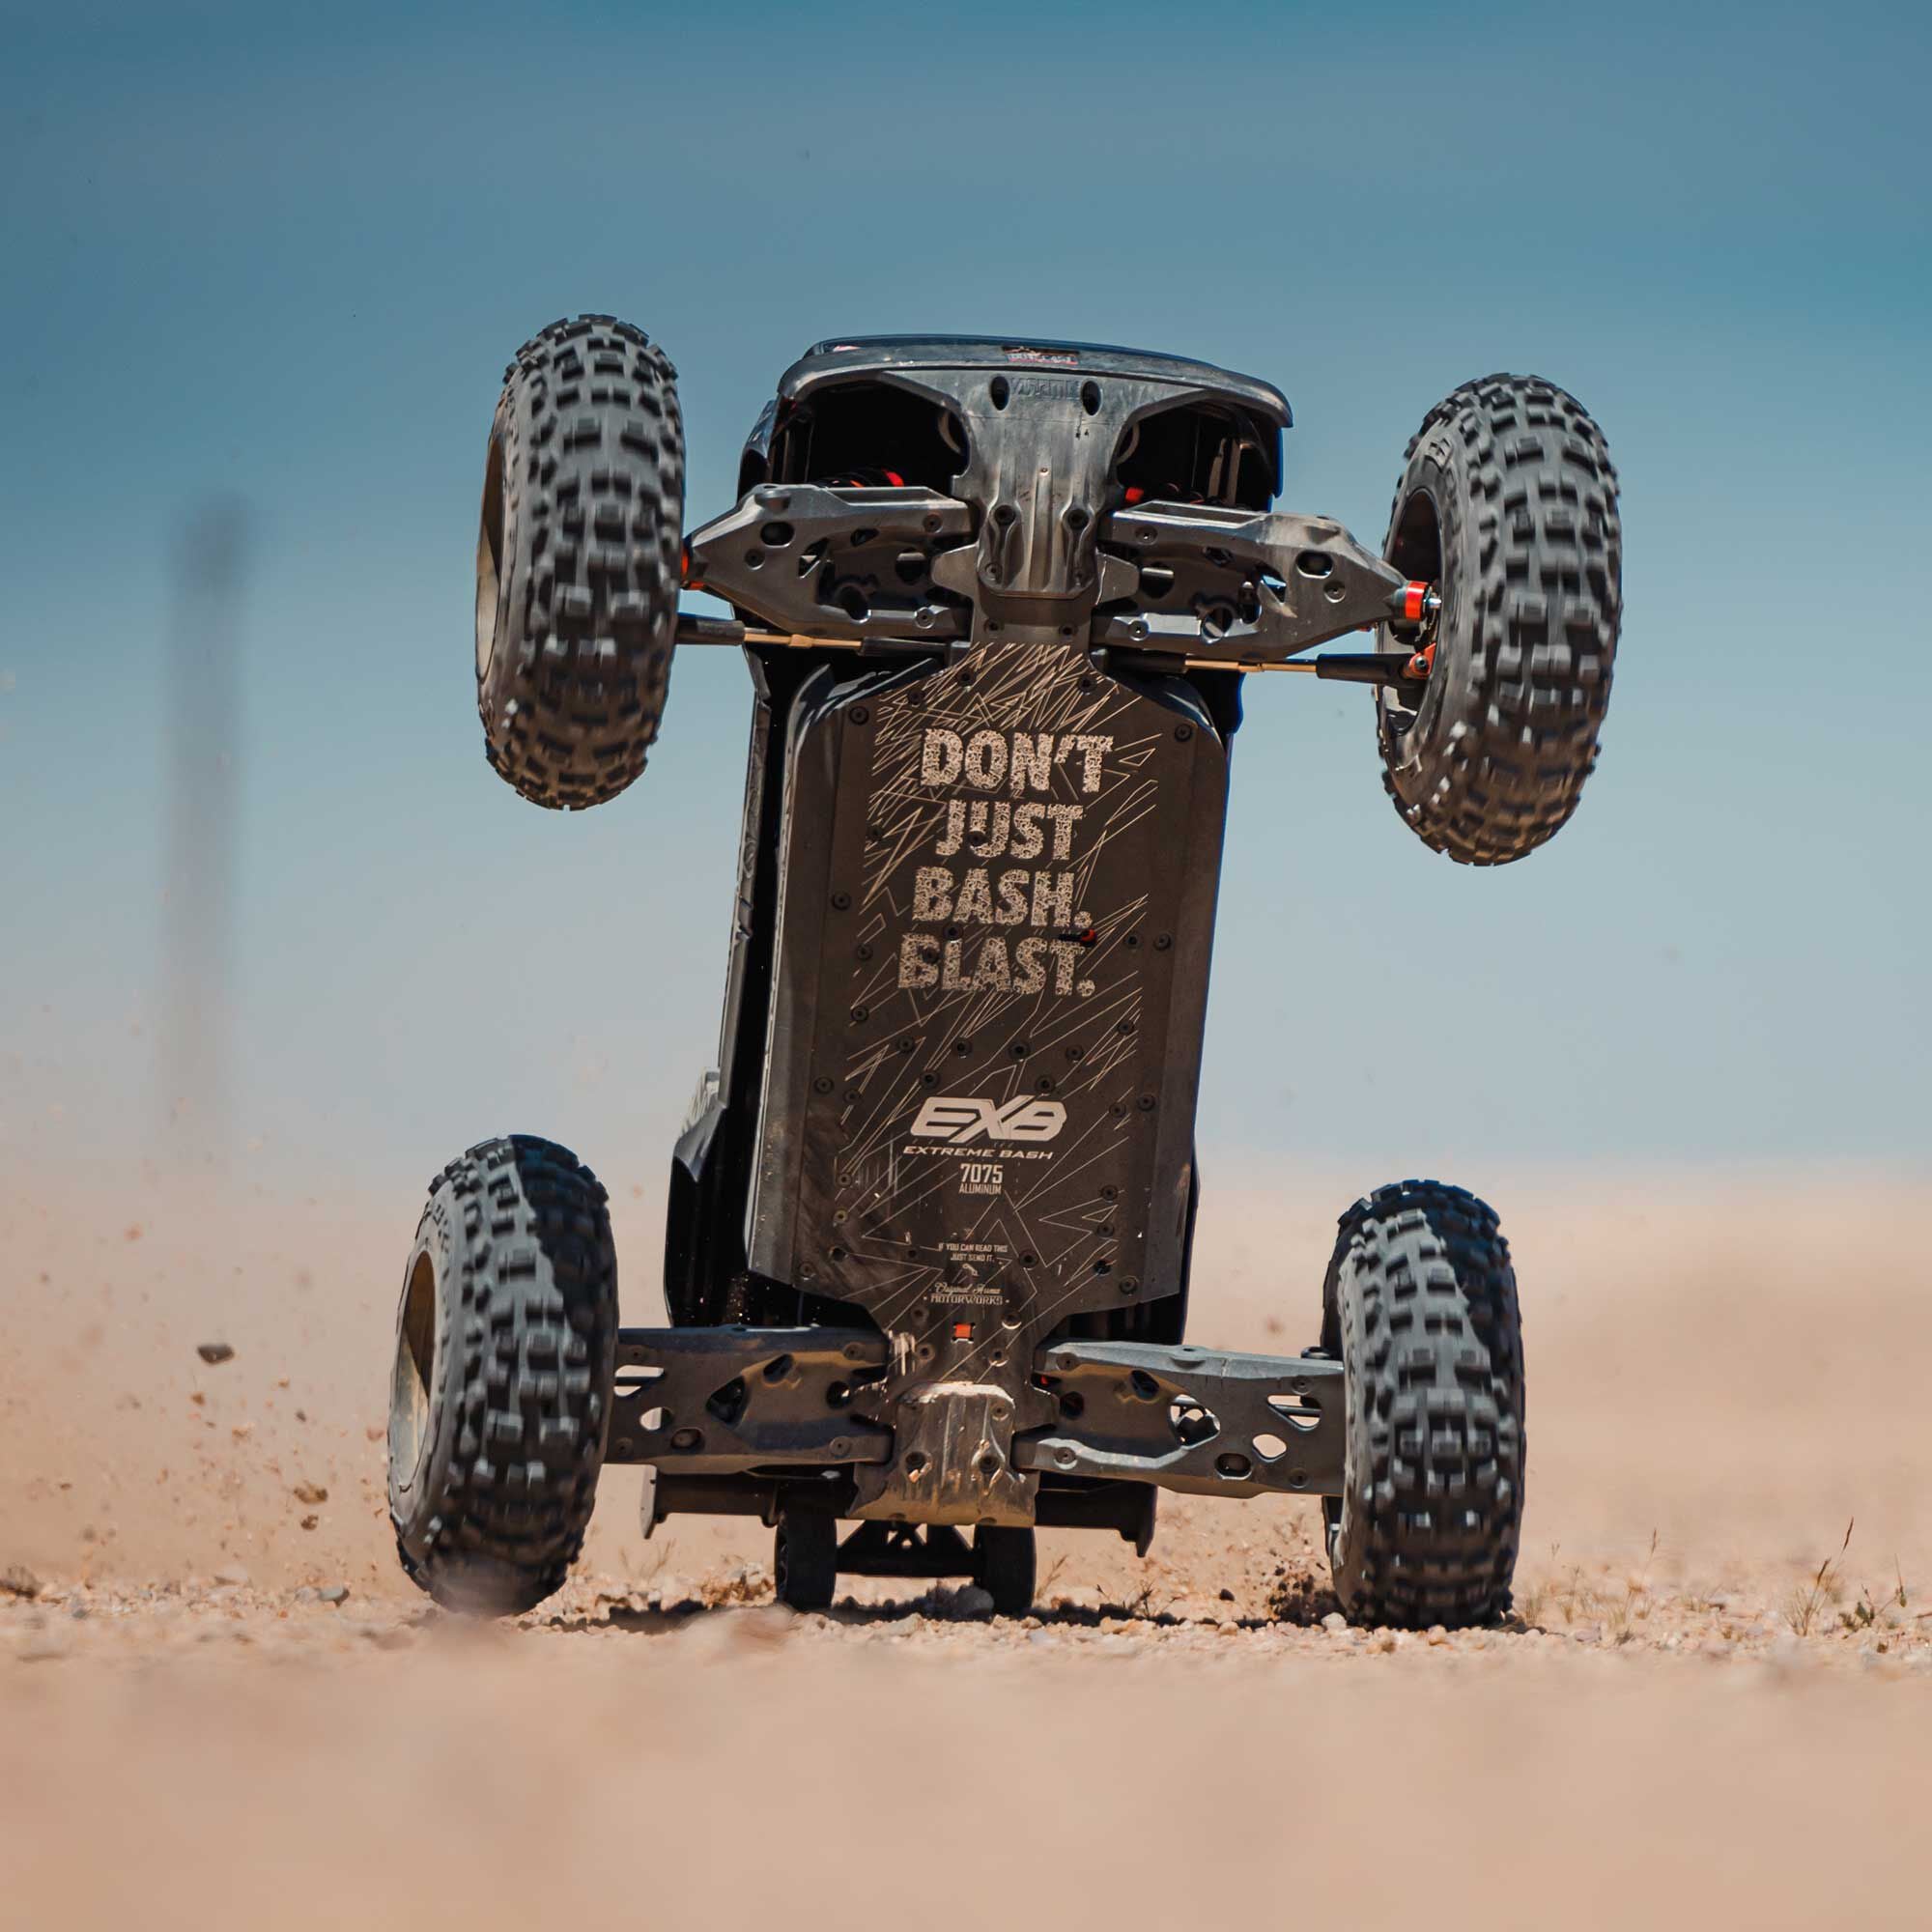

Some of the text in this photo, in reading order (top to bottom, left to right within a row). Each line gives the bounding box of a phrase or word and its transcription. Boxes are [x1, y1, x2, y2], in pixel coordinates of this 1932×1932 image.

[921, 727, 1114, 792] DON'T
[935, 799, 1084, 860] JUST
[912, 866, 1093, 927] BASH.
[898, 932, 1095, 997] BLAST.
[903, 1145, 1054, 1159] EXTREME BASH
[960, 1163, 1004, 1184] 7075
[959, 1183, 1002, 1195] ALUMINUM
[946, 1242, 959, 1252] YOU
[960, 1243, 974, 1252] CAN
[975, 1243, 992, 1252] READ
[930, 1294, 1004, 1305] MOTORWORKS
